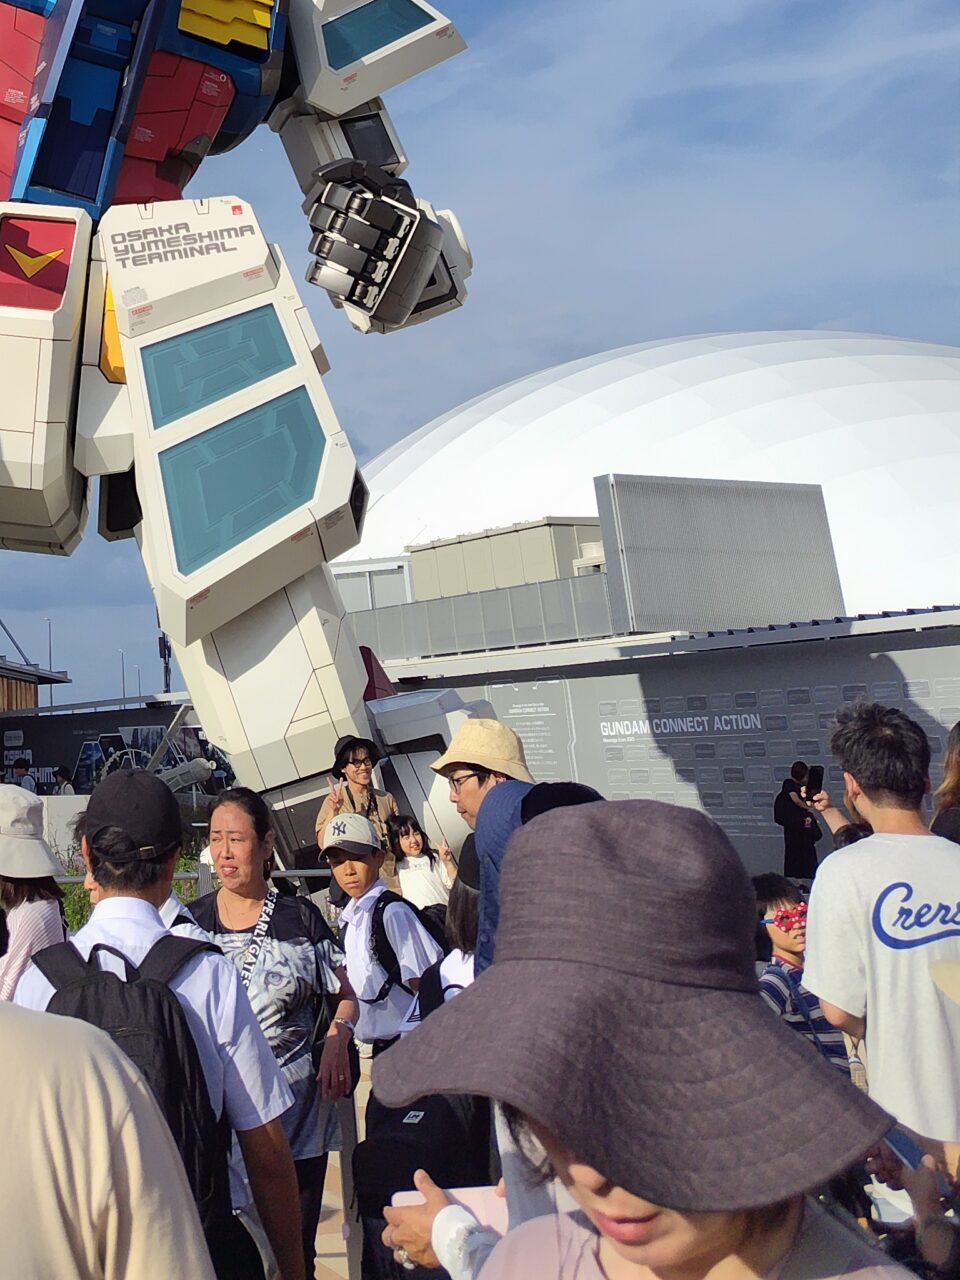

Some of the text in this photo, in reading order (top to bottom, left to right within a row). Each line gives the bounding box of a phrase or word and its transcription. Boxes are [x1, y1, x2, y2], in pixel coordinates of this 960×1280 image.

[110, 222, 190, 245] OSAKA
[113, 224, 255, 257] YUMESHIMA
[116, 241, 237, 269] TERMINAL
[600, 713, 762, 736] GUNDAM CONNECT ACTION
[332, 821, 347, 836] NY
